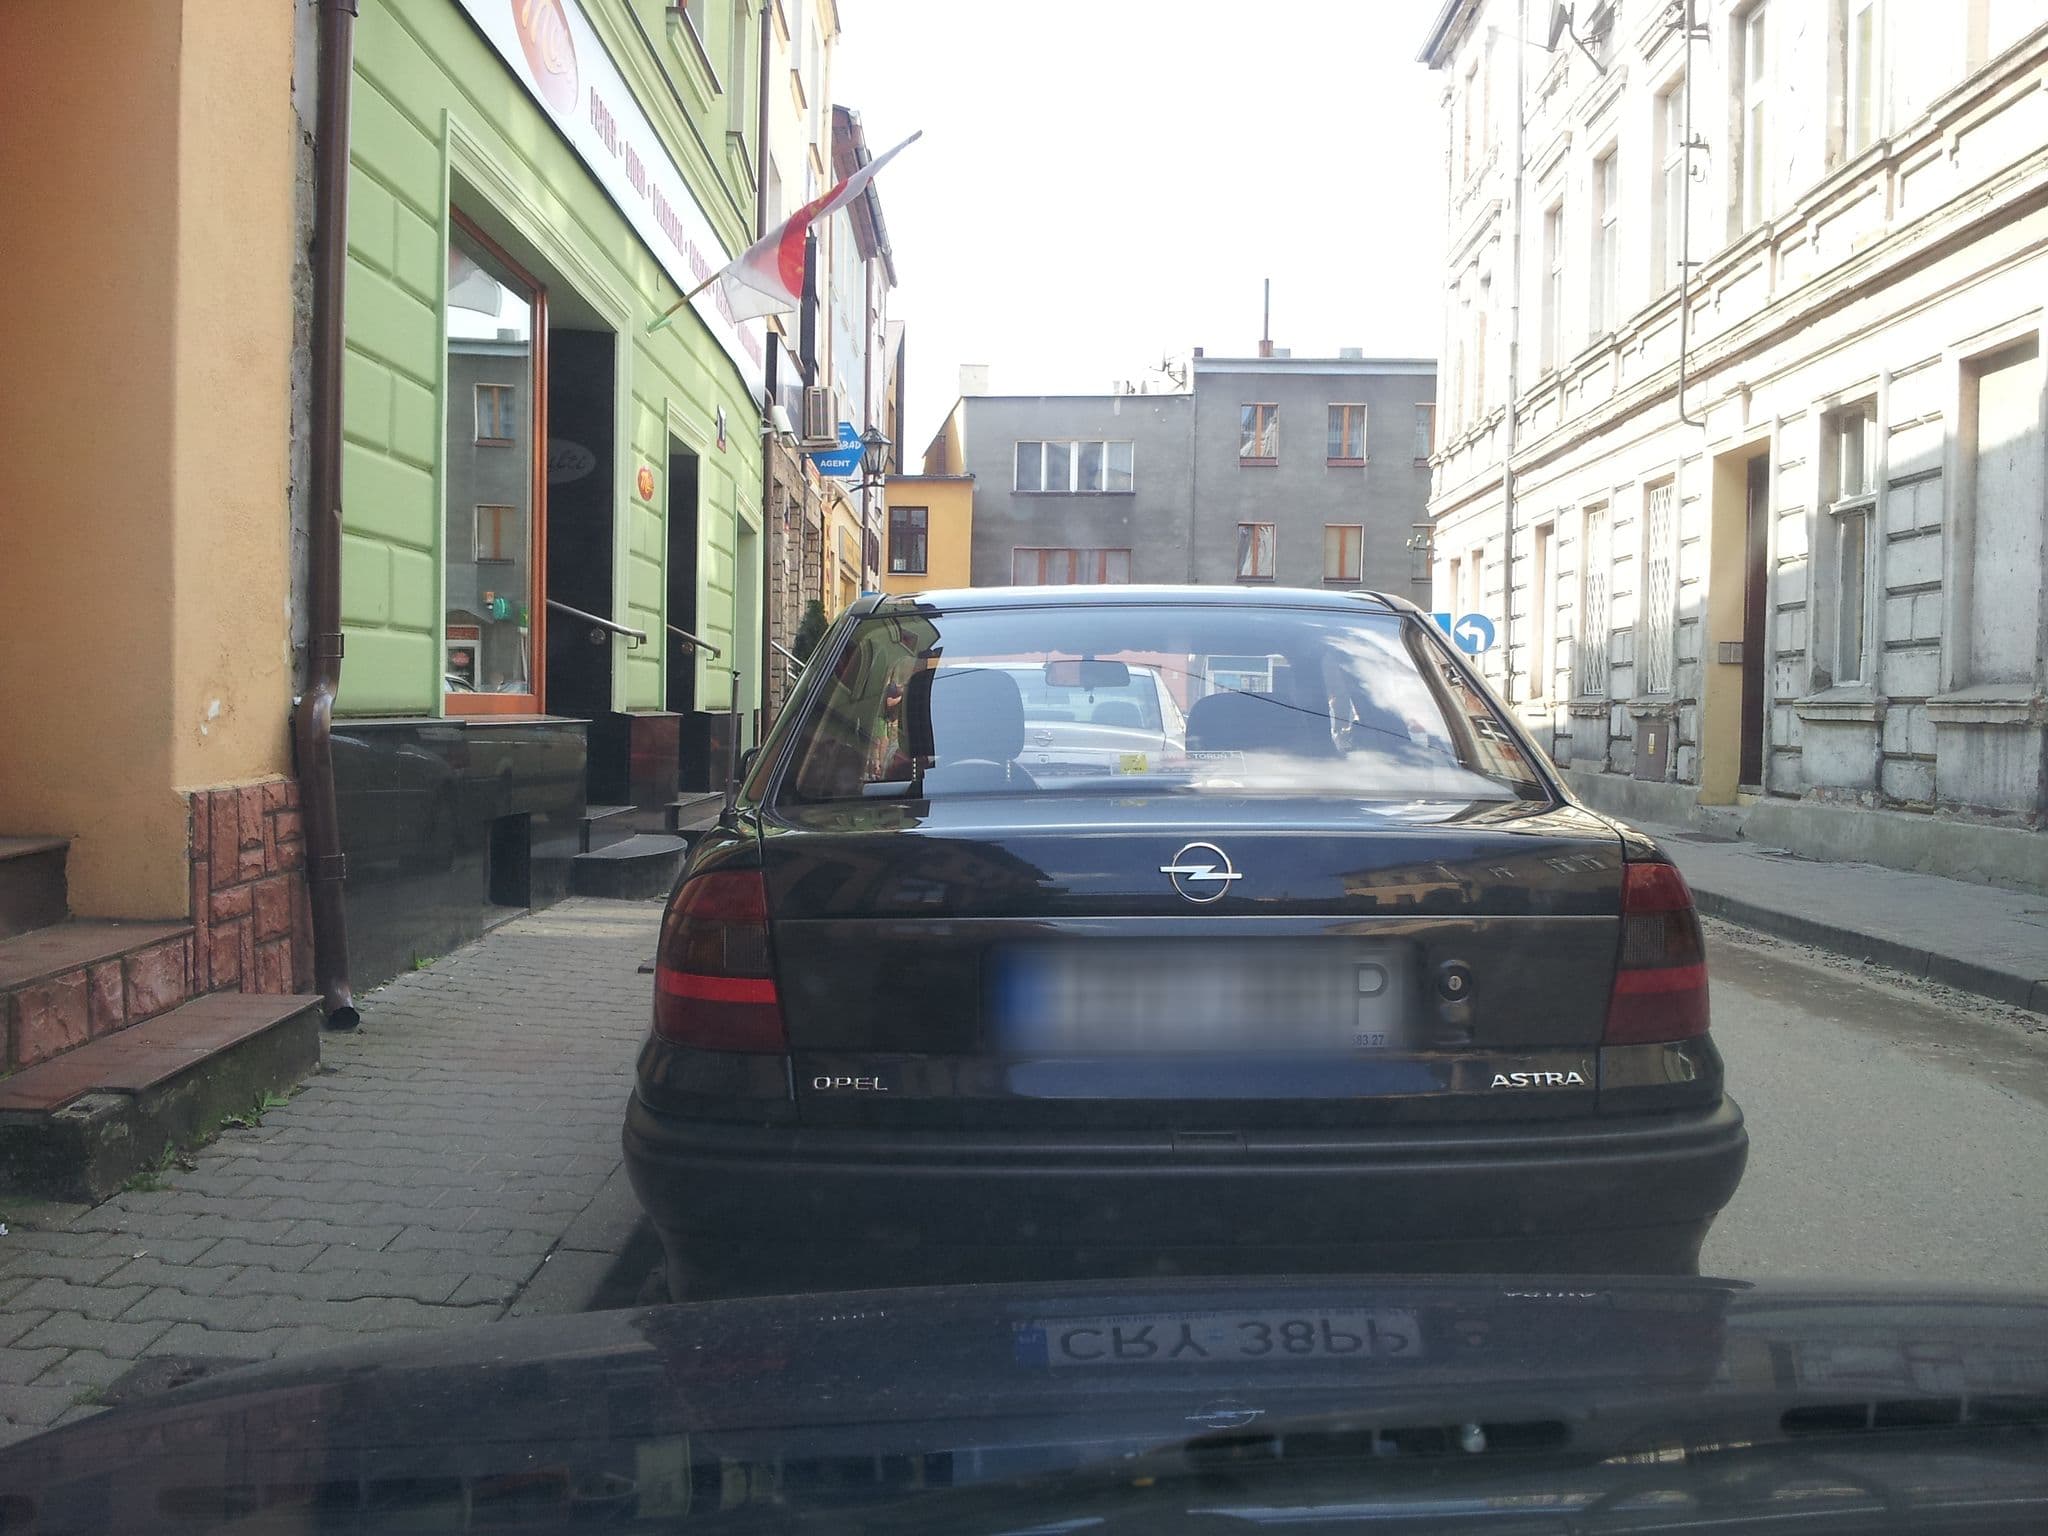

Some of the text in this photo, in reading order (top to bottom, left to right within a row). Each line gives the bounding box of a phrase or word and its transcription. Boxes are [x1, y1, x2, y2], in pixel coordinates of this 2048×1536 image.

[820, 460, 851, 468] AGENT
[813, 1076, 888, 1091] OPEL
[1490, 1072, 1584, 1088] ASTRA
